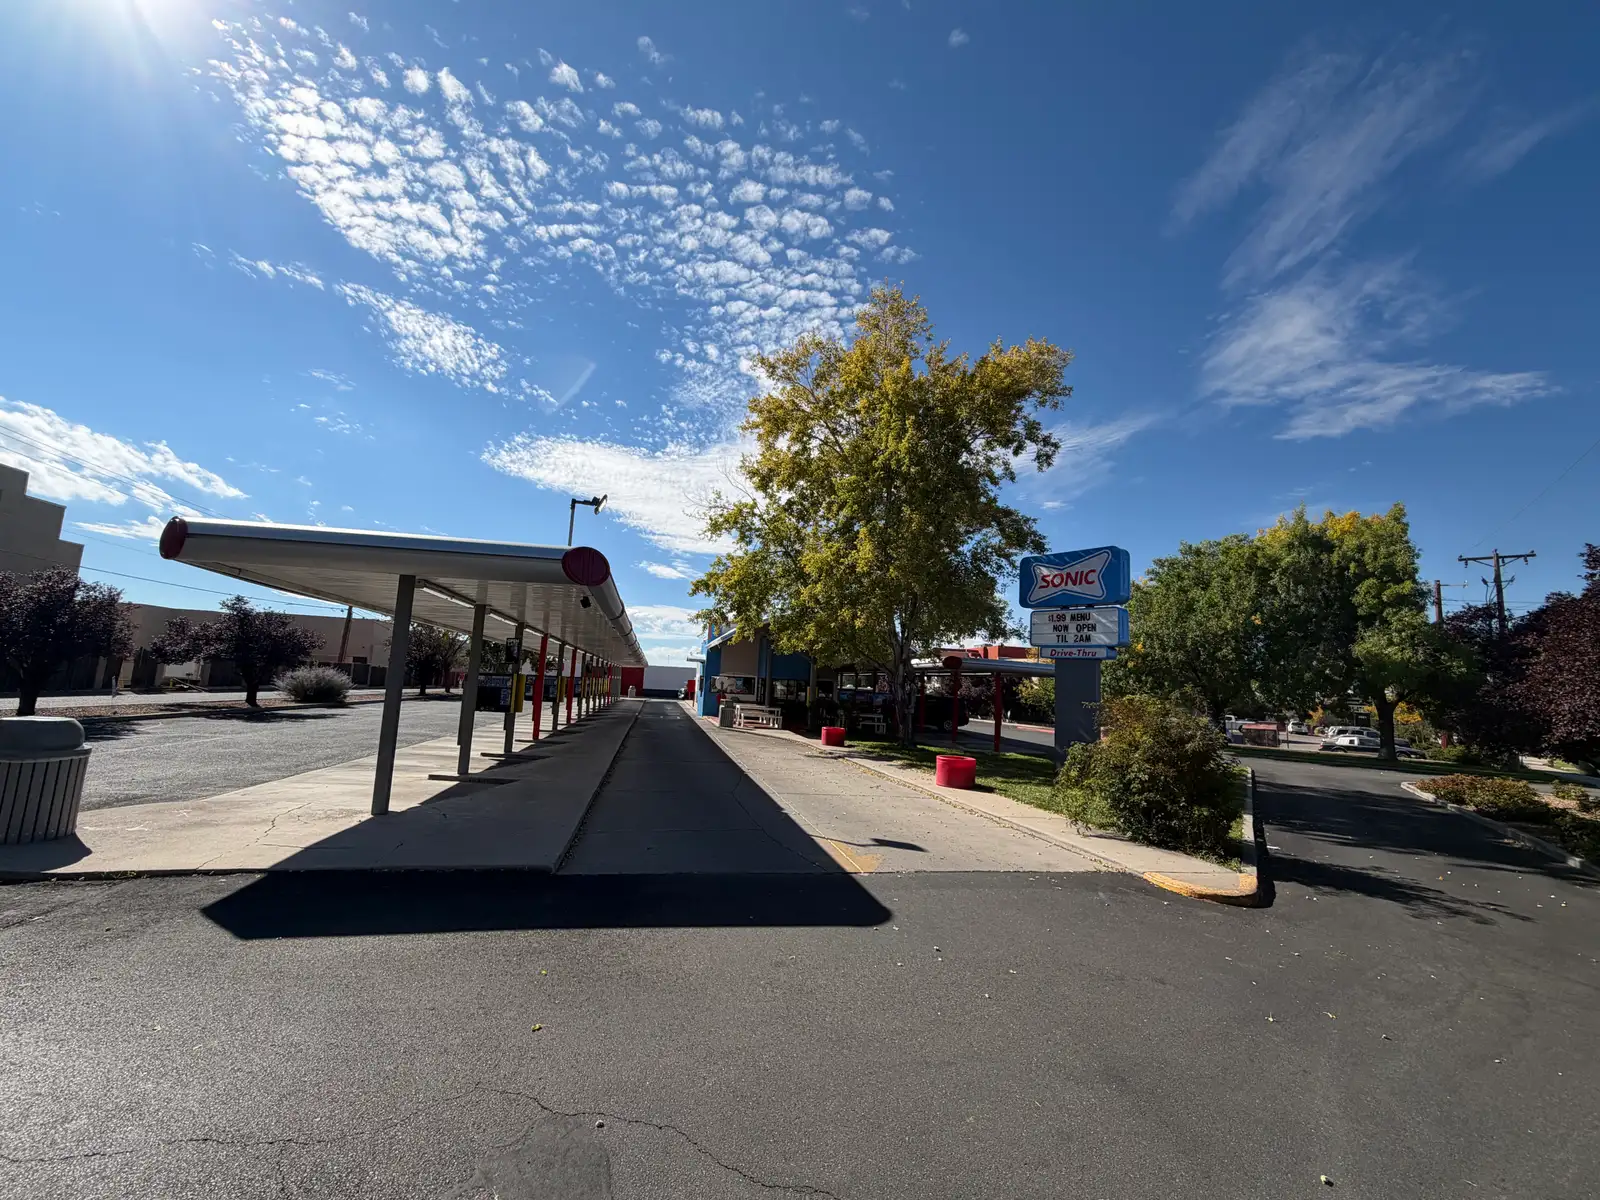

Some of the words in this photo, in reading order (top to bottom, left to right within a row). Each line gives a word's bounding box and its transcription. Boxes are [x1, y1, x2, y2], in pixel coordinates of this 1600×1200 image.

[1039, 569, 1096, 589] SONIC
[1048, 613, 1067, 622] $1.99
[1070, 613, 1091, 622] MENU
[1053, 624, 1069, 633] NOW
[1076, 623, 1097, 632] OPEN
[1056, 635, 1068, 643] TIL
[1074, 634, 1091, 643] 2AM
[1050, 649, 1097, 657] Drive-Thru
